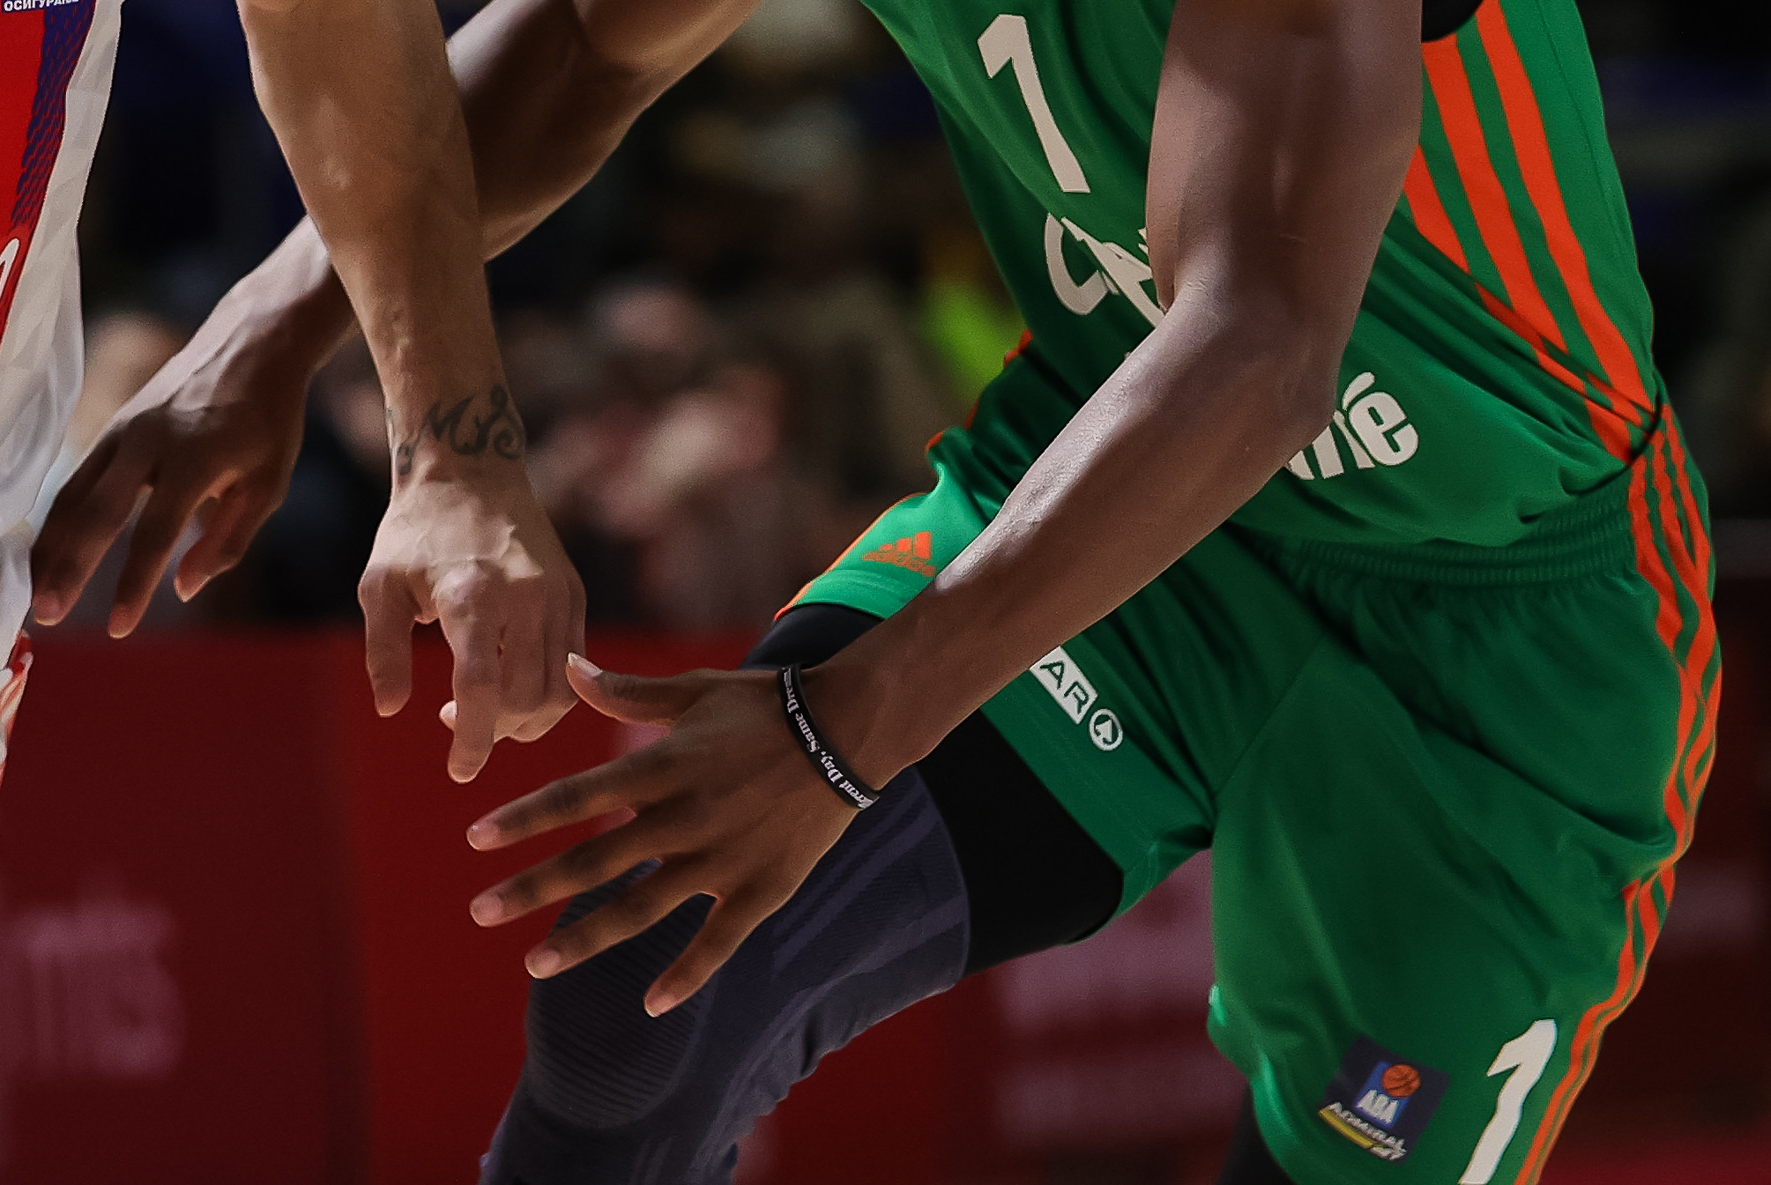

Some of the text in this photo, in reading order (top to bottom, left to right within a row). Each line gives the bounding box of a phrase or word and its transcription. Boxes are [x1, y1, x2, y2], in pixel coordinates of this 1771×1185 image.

[976, 13, 1091, 194] 1
[1039, 659, 1089, 715] AR
[794, 712, 821, 753] Same
[819, 750, 844, 784] Day,
[1457, 1018, 1559, 1185] 1
